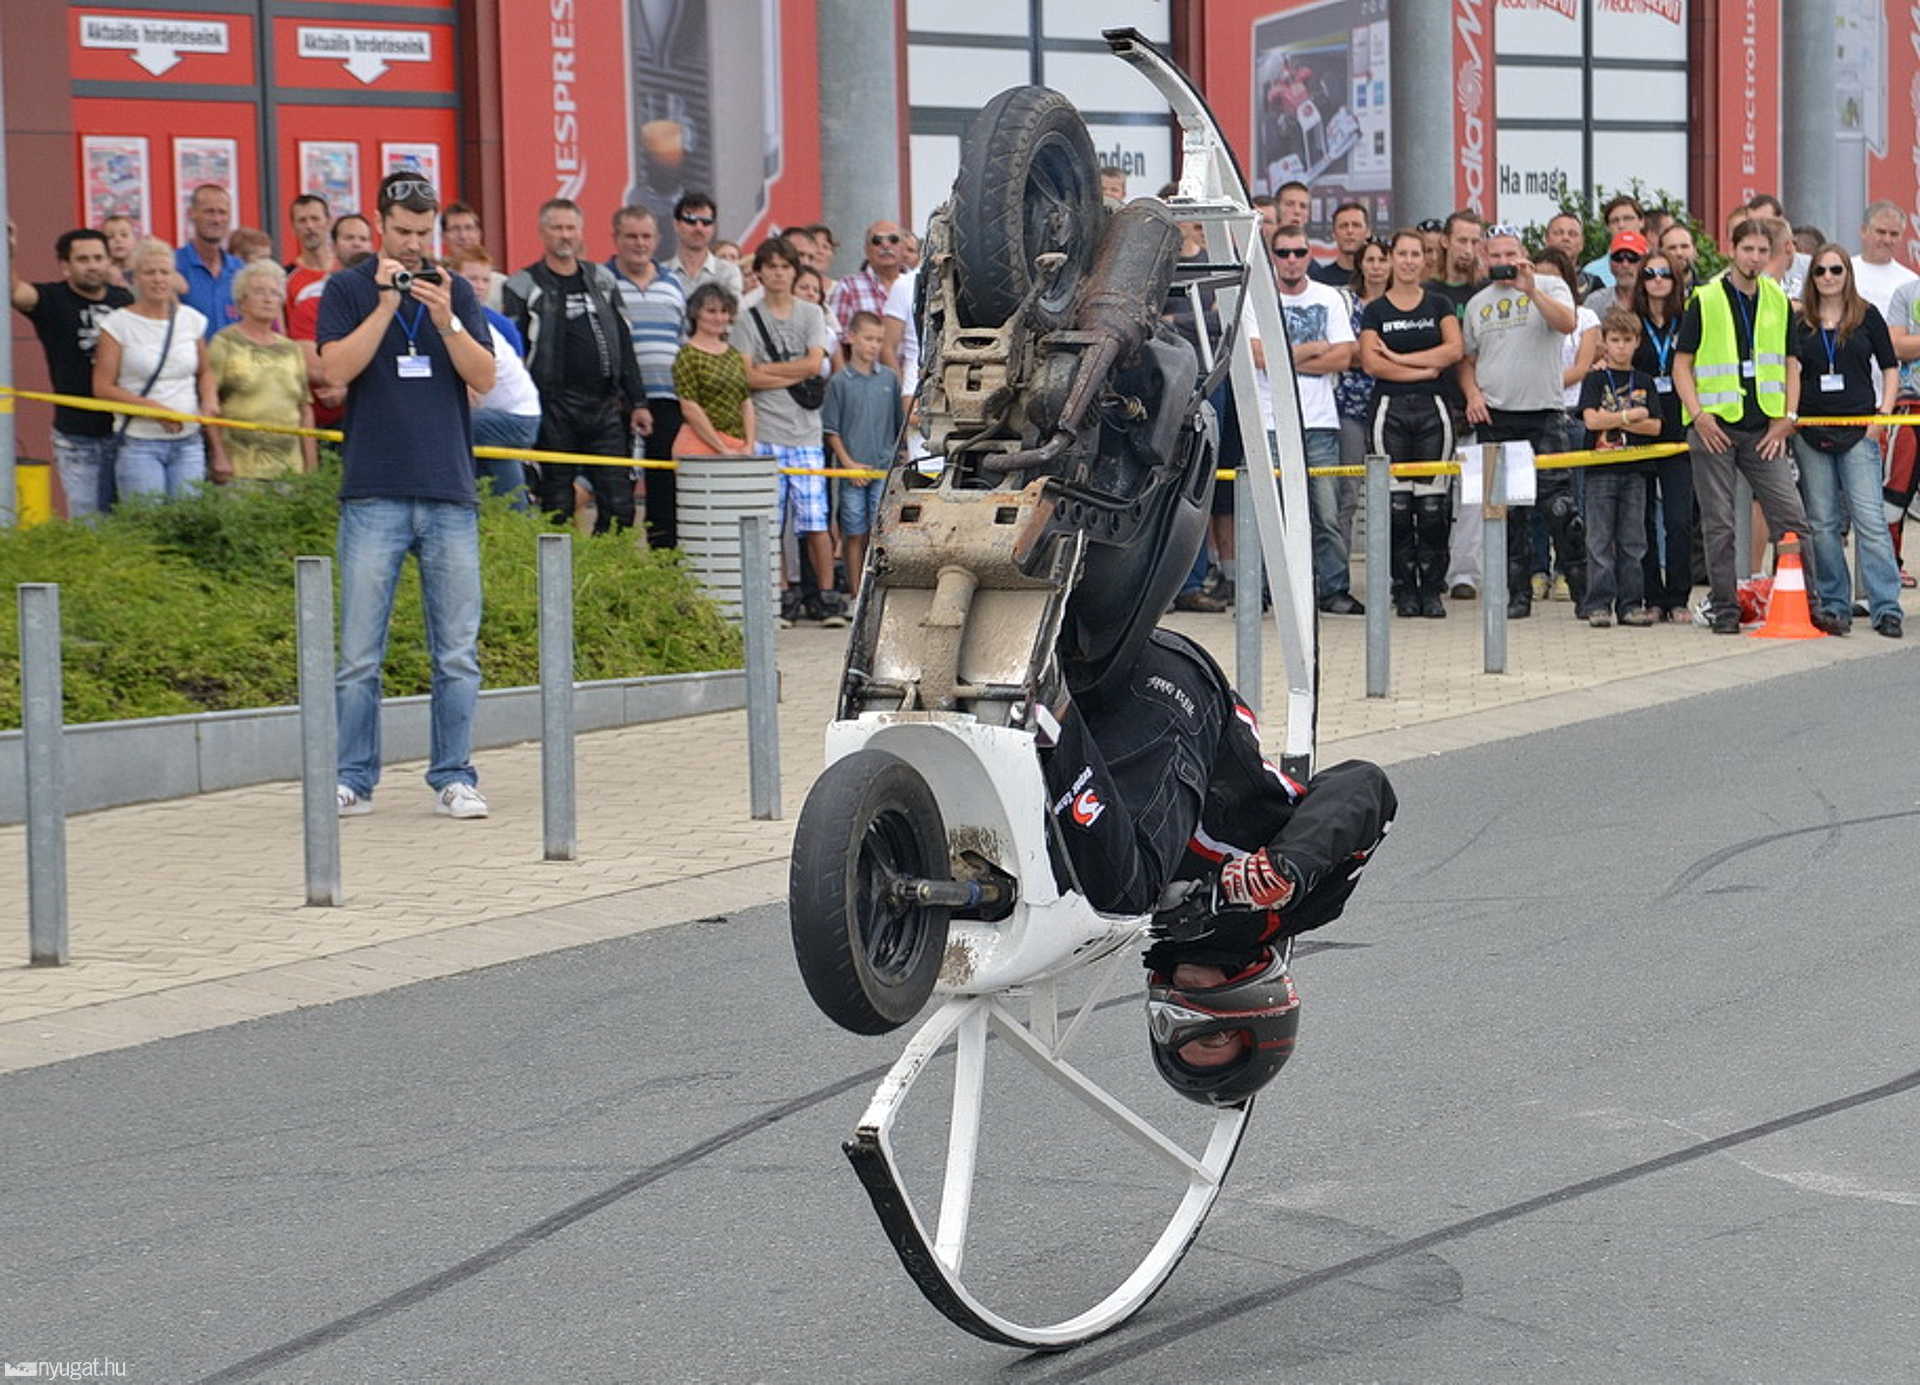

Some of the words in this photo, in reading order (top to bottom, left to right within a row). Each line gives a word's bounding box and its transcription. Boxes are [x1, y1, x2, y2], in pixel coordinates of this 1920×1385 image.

[1096, 142, 1146, 177] nden
[1461, 113, 1483, 218] edia
[1500, 164, 1520, 194] Ha
